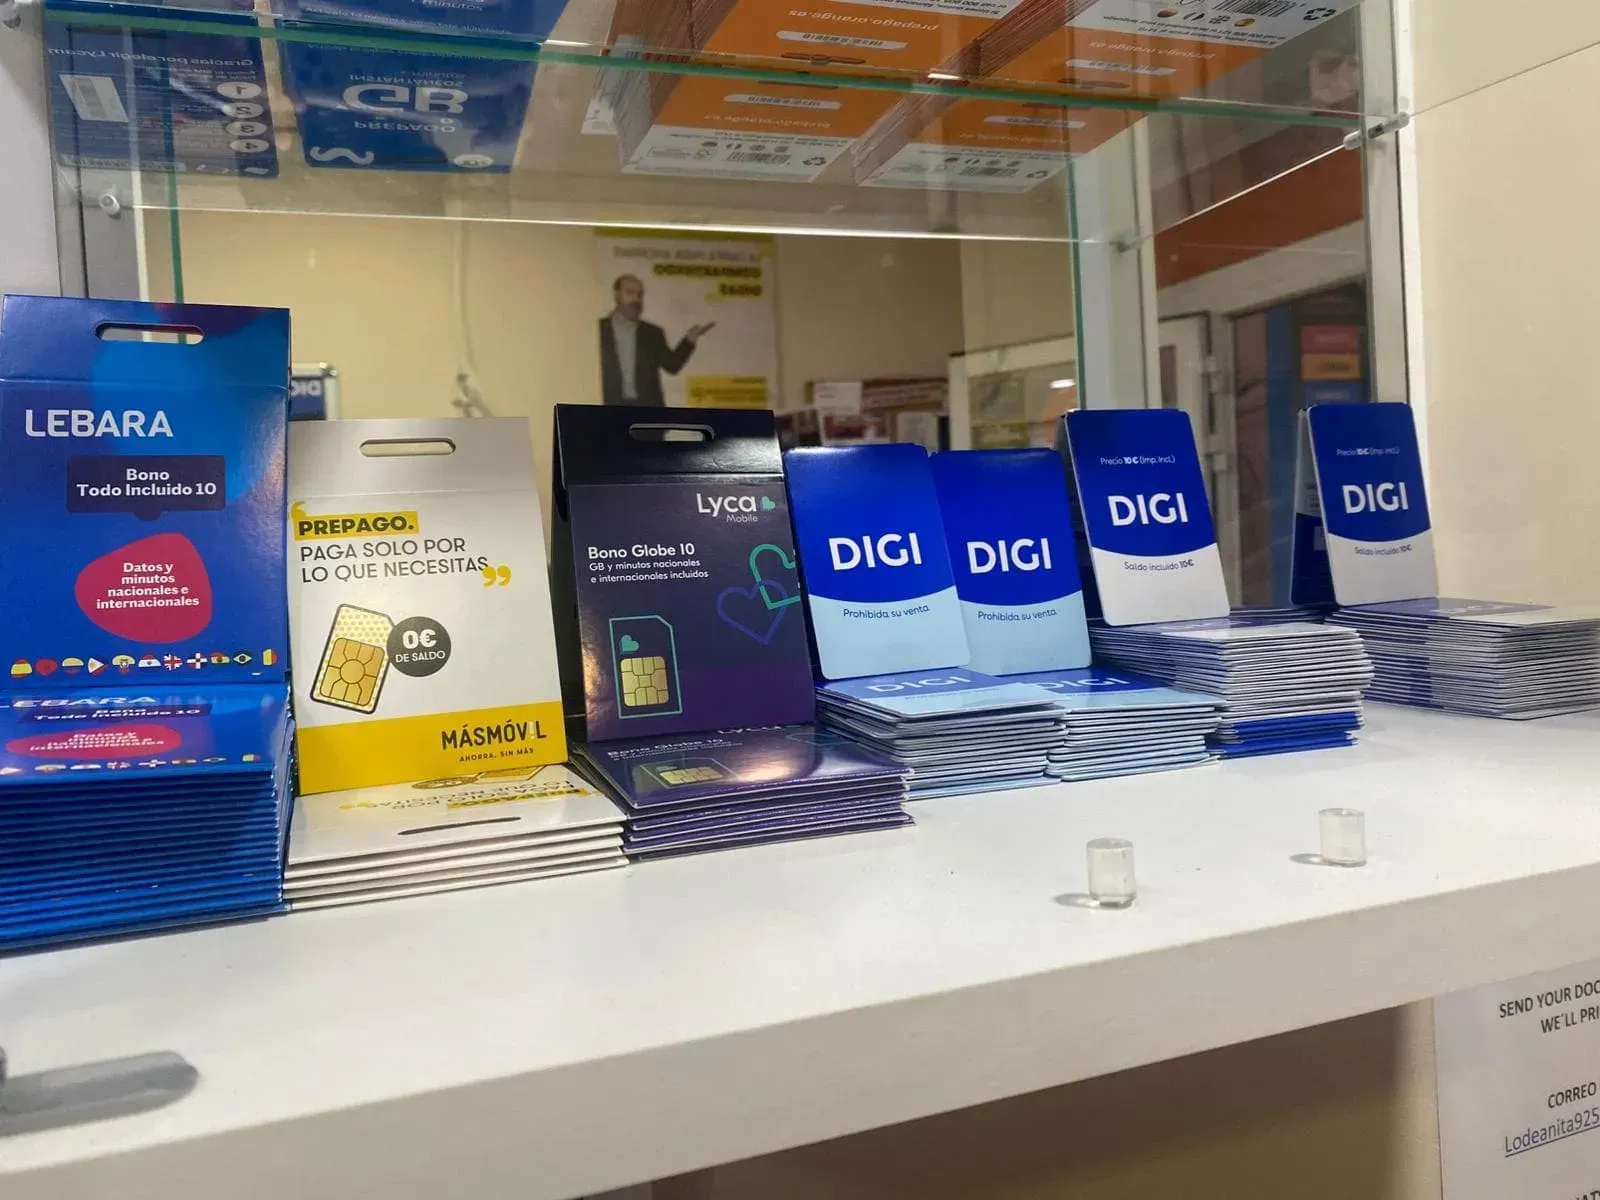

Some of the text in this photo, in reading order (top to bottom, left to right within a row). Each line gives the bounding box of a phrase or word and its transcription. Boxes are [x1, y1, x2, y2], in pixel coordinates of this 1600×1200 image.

[788, 9, 940, 31] prepago.orange.es
[25, 409, 174, 438] LEBARA
[1100, 457, 1123, 465] Precio
[1123, 456, 1139, 465] 10€
[126, 468, 170, 481] Bono
[76, 482, 217, 497] Todo Incluido 10
[696, 493, 757, 518] Lyca
[1342, 482, 1409, 514] DIGI
[1107, 492, 1189, 527] DIGI
[298, 515, 415, 537] PREPAGO.
[726, 514, 758, 524] Mobile
[300, 537, 467, 562] PAGA SOLO POR
[588, 543, 695, 560] Bono Globe 10
[828, 532, 922, 571] DIGI
[966, 538, 1052, 575] DIGI
[1354, 546, 1374, 556] Saldo
[123, 562, 174, 575] Datos y
[302, 556, 489, 584] LO QUE NECESITAS
[589, 559, 701, 572] GB y minutos nacionales
[1124, 559, 1195, 571] Saldo incluido 10€
[121, 573, 176, 585] minutos
[599, 571, 668, 584] internacionales
[670, 569, 709, 580] incluidos
[107, 586, 189, 597] nacionales e
[96, 596, 200, 610] internacionales
[843, 605, 930, 619] Prohibida su venta
[978, 608, 1057, 622] Prohibida su venta
[402, 628, 438, 650] 0€
[395, 650, 447, 664] DE SALDO
[865, 676, 972, 692] DIGI
[1041, 677, 1130, 689] DIGI
[1499, 979, 1600, 1019] SEND YOUR DOC
[1580, 1005, 1600, 1023] PRI
[1548, 1081, 1597, 1108] CORREO
